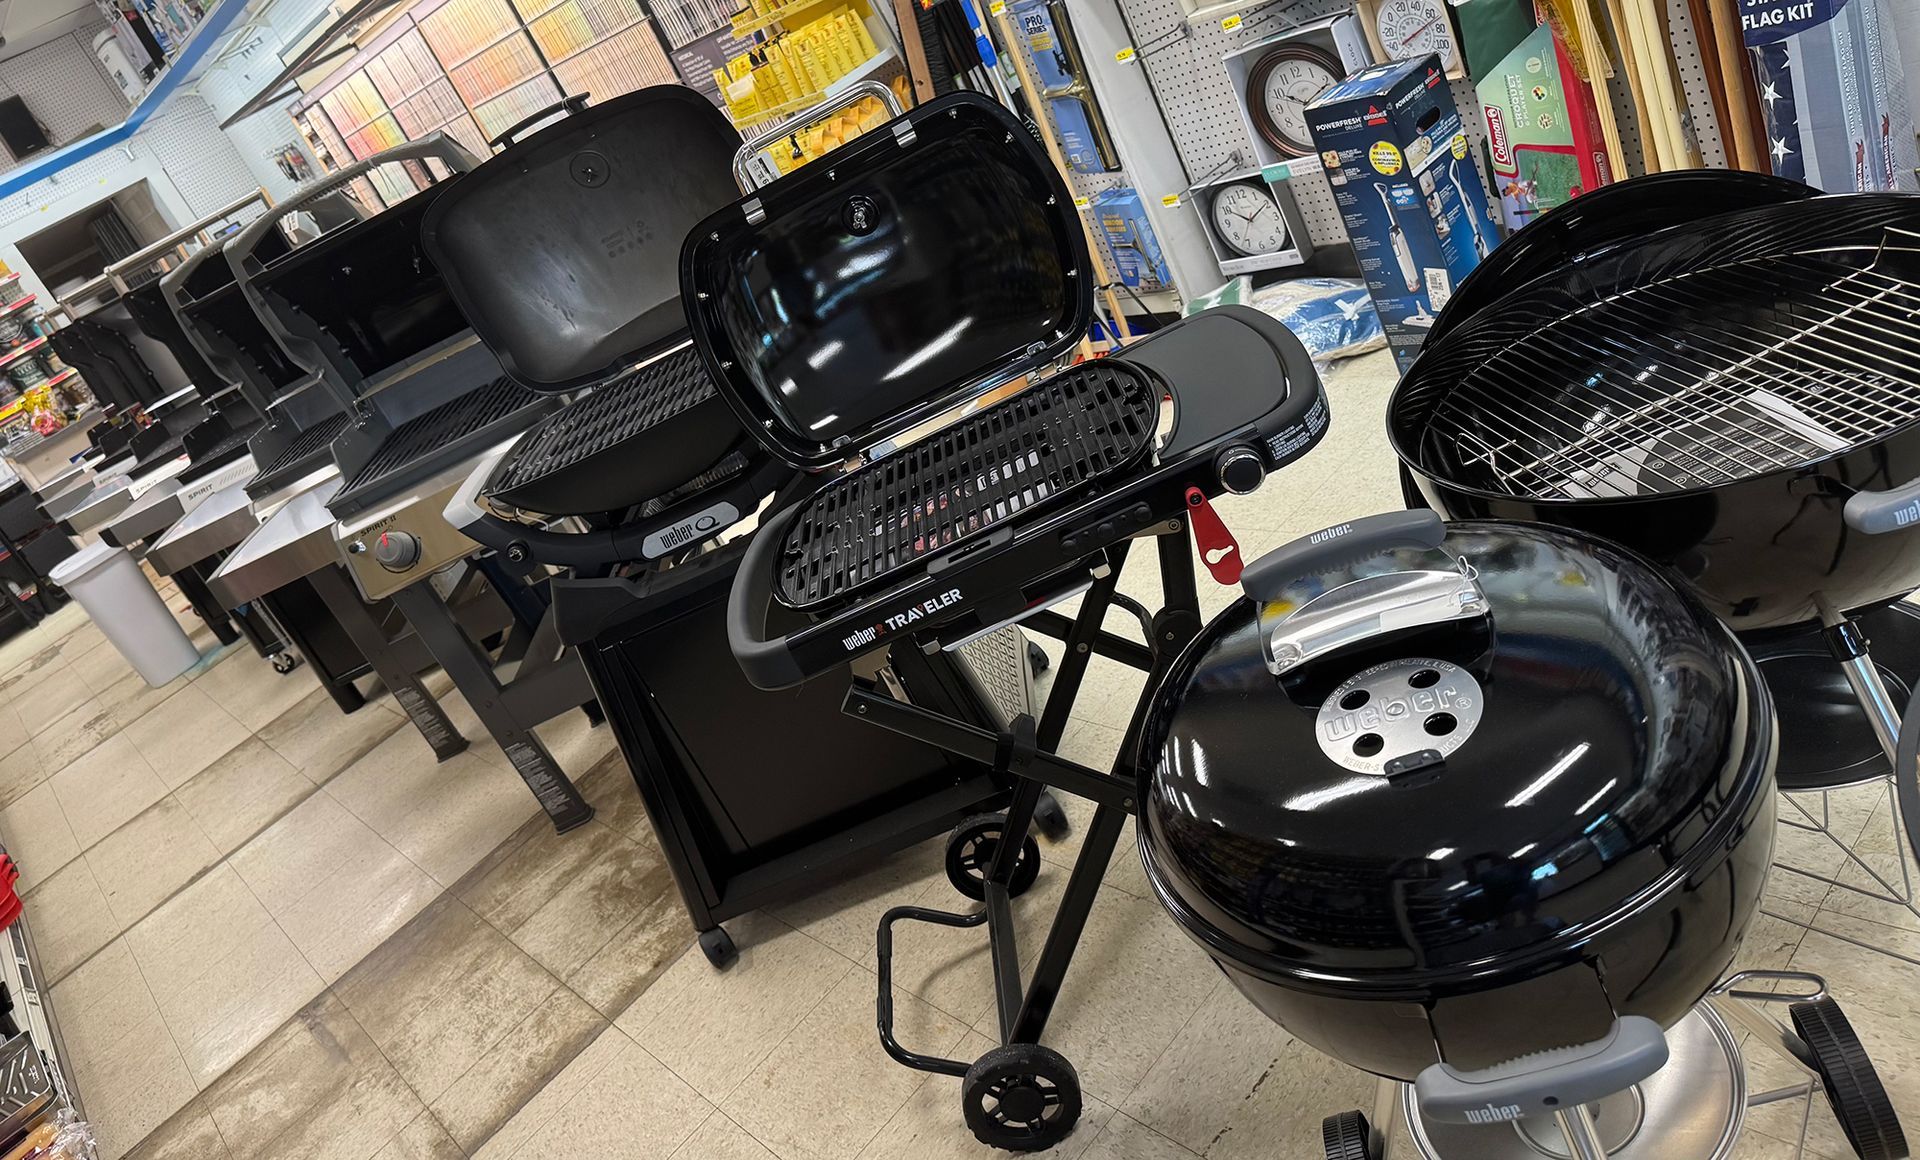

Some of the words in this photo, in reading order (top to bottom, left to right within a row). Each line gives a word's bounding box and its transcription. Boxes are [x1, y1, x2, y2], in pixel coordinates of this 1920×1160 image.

[1395, 1, 1406, 12] 20
[1410, 1, 1421, 11] 40
[1387, 12, 1394, 22] 0
[1425, 8, 1436, 19] 60
[1741, 8, 1785, 31] FLAG
[1787, 3, 1814, 22] KIT
[1025, 14, 1043, 28] PRO
[1026, 25, 1048, 36] SERIES
[1435, 23, 1446, 33] 80
[1437, 40, 1449, 50] 100
[1839, 47, 1848, 70] FLAG
[1289, 66, 1302, 79] 12
[1308, 67, 1315, 79] 1
[1279, 73, 1289, 86] 11
[1842, 71, 1852, 101] STATES
[1874, 76, 1882, 108] UNITED
[1272, 88, 1286, 100] 10
[1394, 82, 1426, 110] POWERFRESH
[1508, 74, 1523, 128] CROQUET
[1518, 89, 1529, 120] PLAYER
[1275, 104, 1284, 115] 9
[1284, 117, 1293, 128] 8
[1315, 116, 1362, 132] POWERFRESH
[1847, 103, 1856, 136] UNITED
[1298, 125, 1306, 137] 7
[1491, 118, 1507, 162] Coleman
[1226, 195, 1236, 205] 11
[1235, 188, 1247, 200] 12
[1252, 191, 1258, 200] 1
[1222, 205, 1232, 215] 10
[1272, 211, 1280, 221] 3
[1224, 219, 1231, 228] 9
[1232, 231, 1240, 241] 8
[1275, 226, 1281, 235] 4
[1244, 238, 1251, 248] 7
[1258, 240, 1266, 250] 6
[1268, 235, 1276, 246] 5
[136, 479, 158, 494] SPIRIT
[187, 483, 214, 501] SPIRIT
[360, 518, 388, 537] SPIRIT
[660, 523, 693, 549] weber
[1310, 523, 1352, 545] weber
[842, 625, 877, 651] weber
[885, 588, 963, 631] TRAVELER
[1324, 685, 1457, 742] weber
[1342, 755, 1384, 772] WEBER-S
[1463, 1102, 1522, 1124] weber
